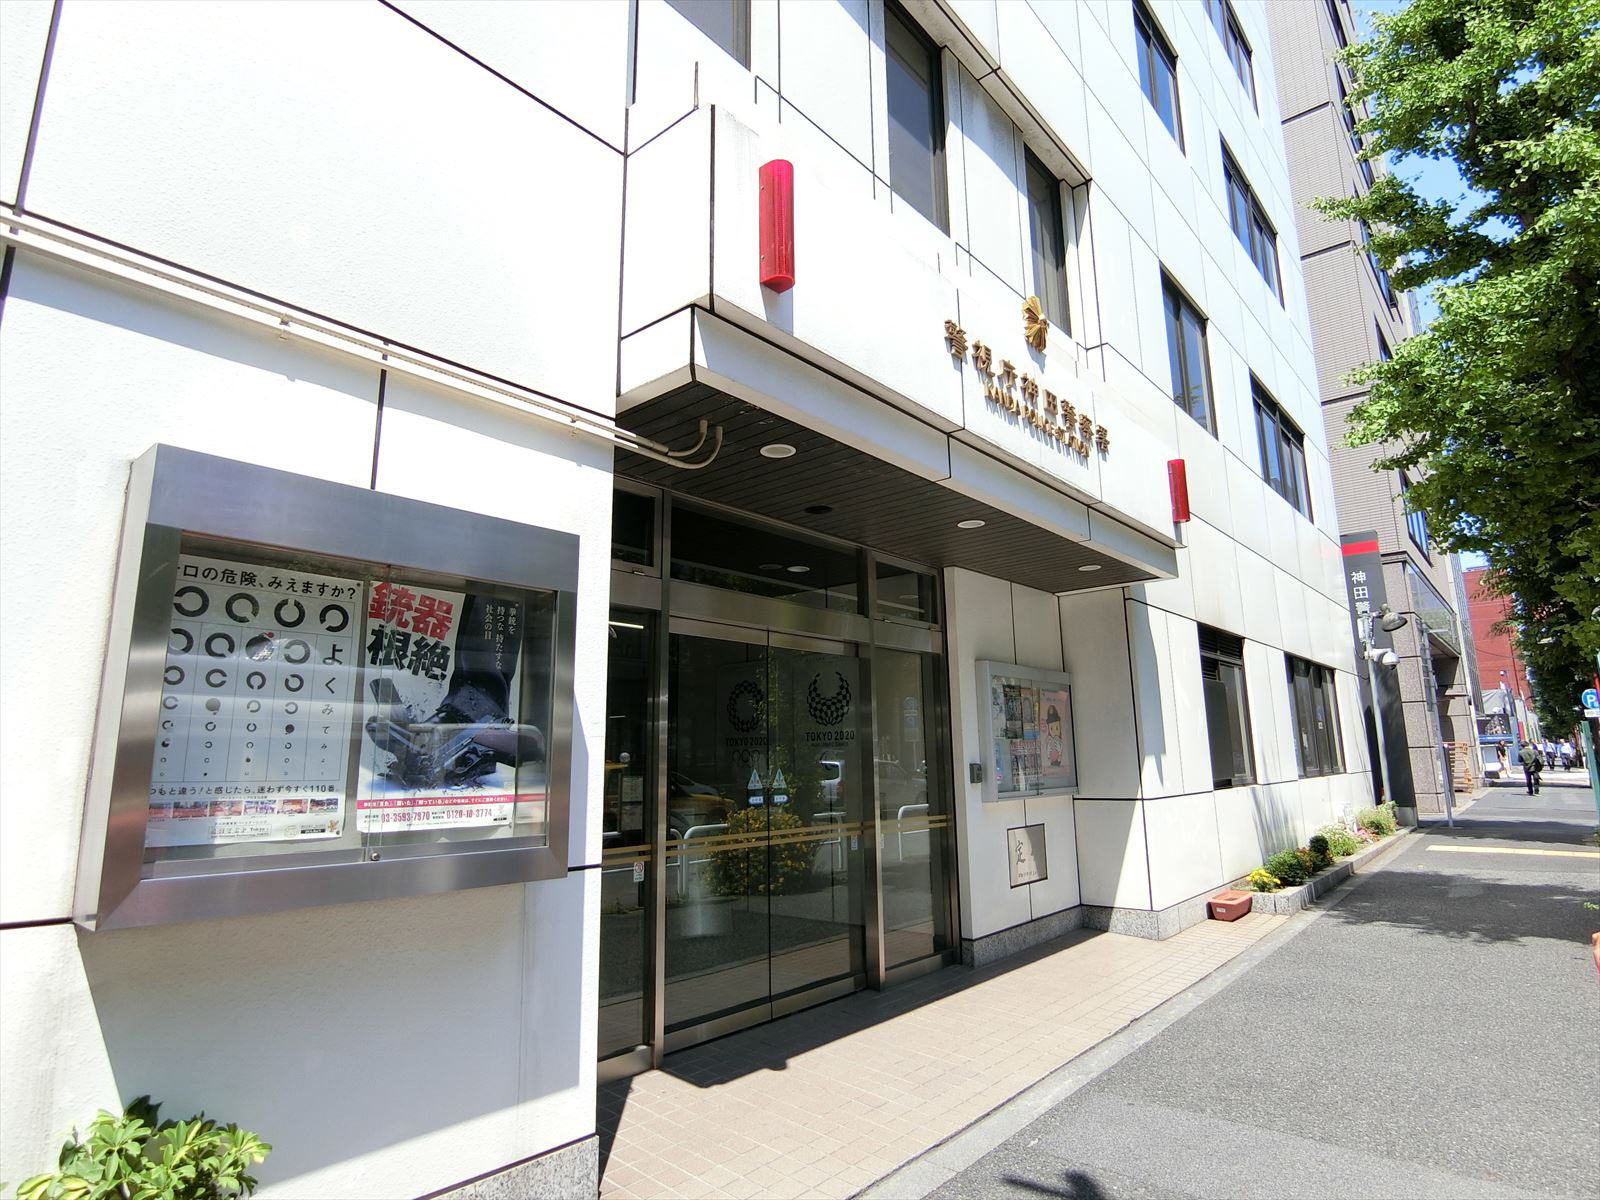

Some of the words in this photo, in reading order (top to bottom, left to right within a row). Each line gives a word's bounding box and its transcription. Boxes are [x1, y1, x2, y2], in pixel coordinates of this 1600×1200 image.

[944, 319, 1110, 453] 警視庁神田警察署
[983, 378, 1021, 416] KANDA
[1020, 404, 1055, 437] POLICE
[177, 565, 357, 600] ロの危険、みえますか？
[368, 581, 454, 641] 銃器
[484, 604, 494, 640] 社会の目
[496, 606, 506, 631] 持つな
[366, 624, 452, 681] 根絶
[495, 633, 505, 670] 持たすな
[725, 737, 749, 748] TOKYO
[749, 736, 768, 746] 2020
[805, 731, 833, 742] TOKYO
[834, 730, 855, 741] 2020
